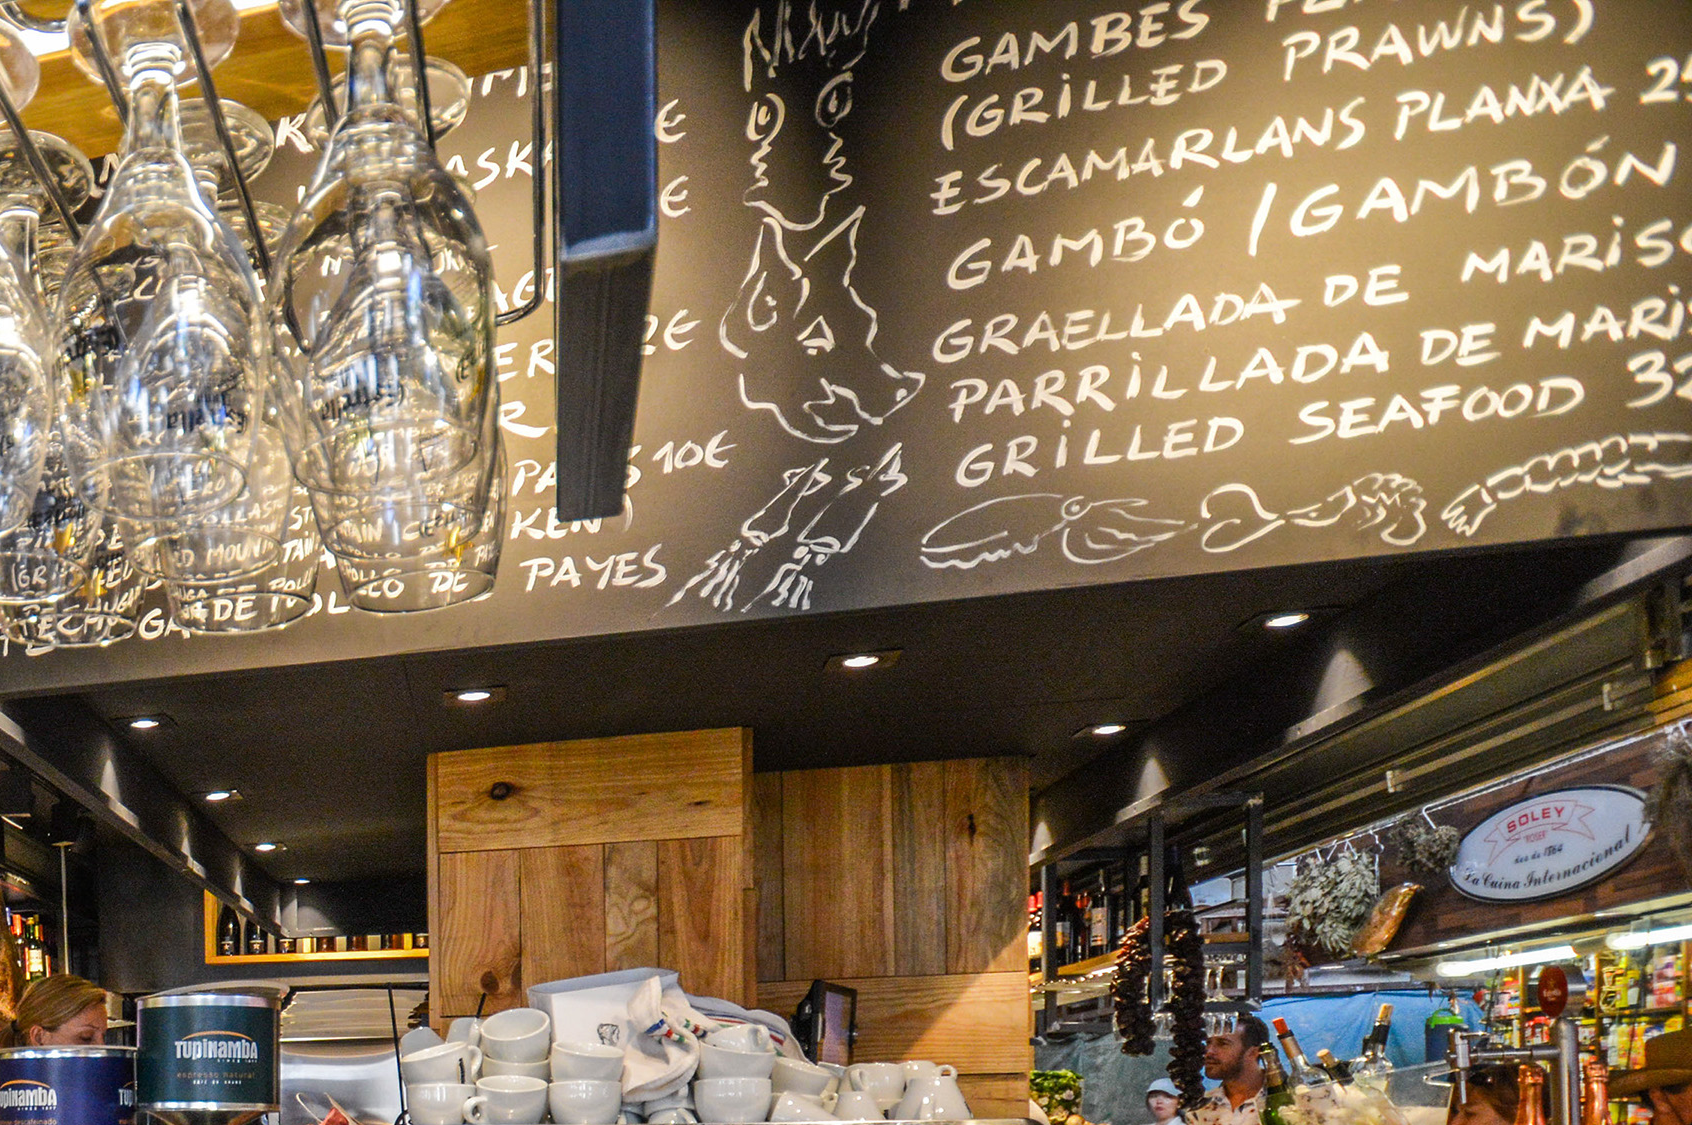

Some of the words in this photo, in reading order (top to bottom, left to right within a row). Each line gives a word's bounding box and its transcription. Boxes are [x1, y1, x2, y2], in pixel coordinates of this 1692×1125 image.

[941, 0, 1210, 83] GAMBES
[1282, 0, 1594, 82] PRAWNS)
[930, 97, 1366, 215] ESCAMARLANS
[1395, 66, 1615, 140] PLANXA
[947, 185, 1205, 290] GAMBÓ
[933, 283, 1302, 364] GRAELLADA
[1323, 264, 1410, 308] DE
[1419, 321, 1503, 367] DE
[1521, 283, 1692, 350] MARi
[1288, 376, 1585, 444] SEAFOOD
[519, 543, 668, 593] PAYES
[1481, 872, 1521, 890] Cuina
[1522, 824, 1632, 888] Internacional
[1506, 805, 1566, 834] SOLEY
